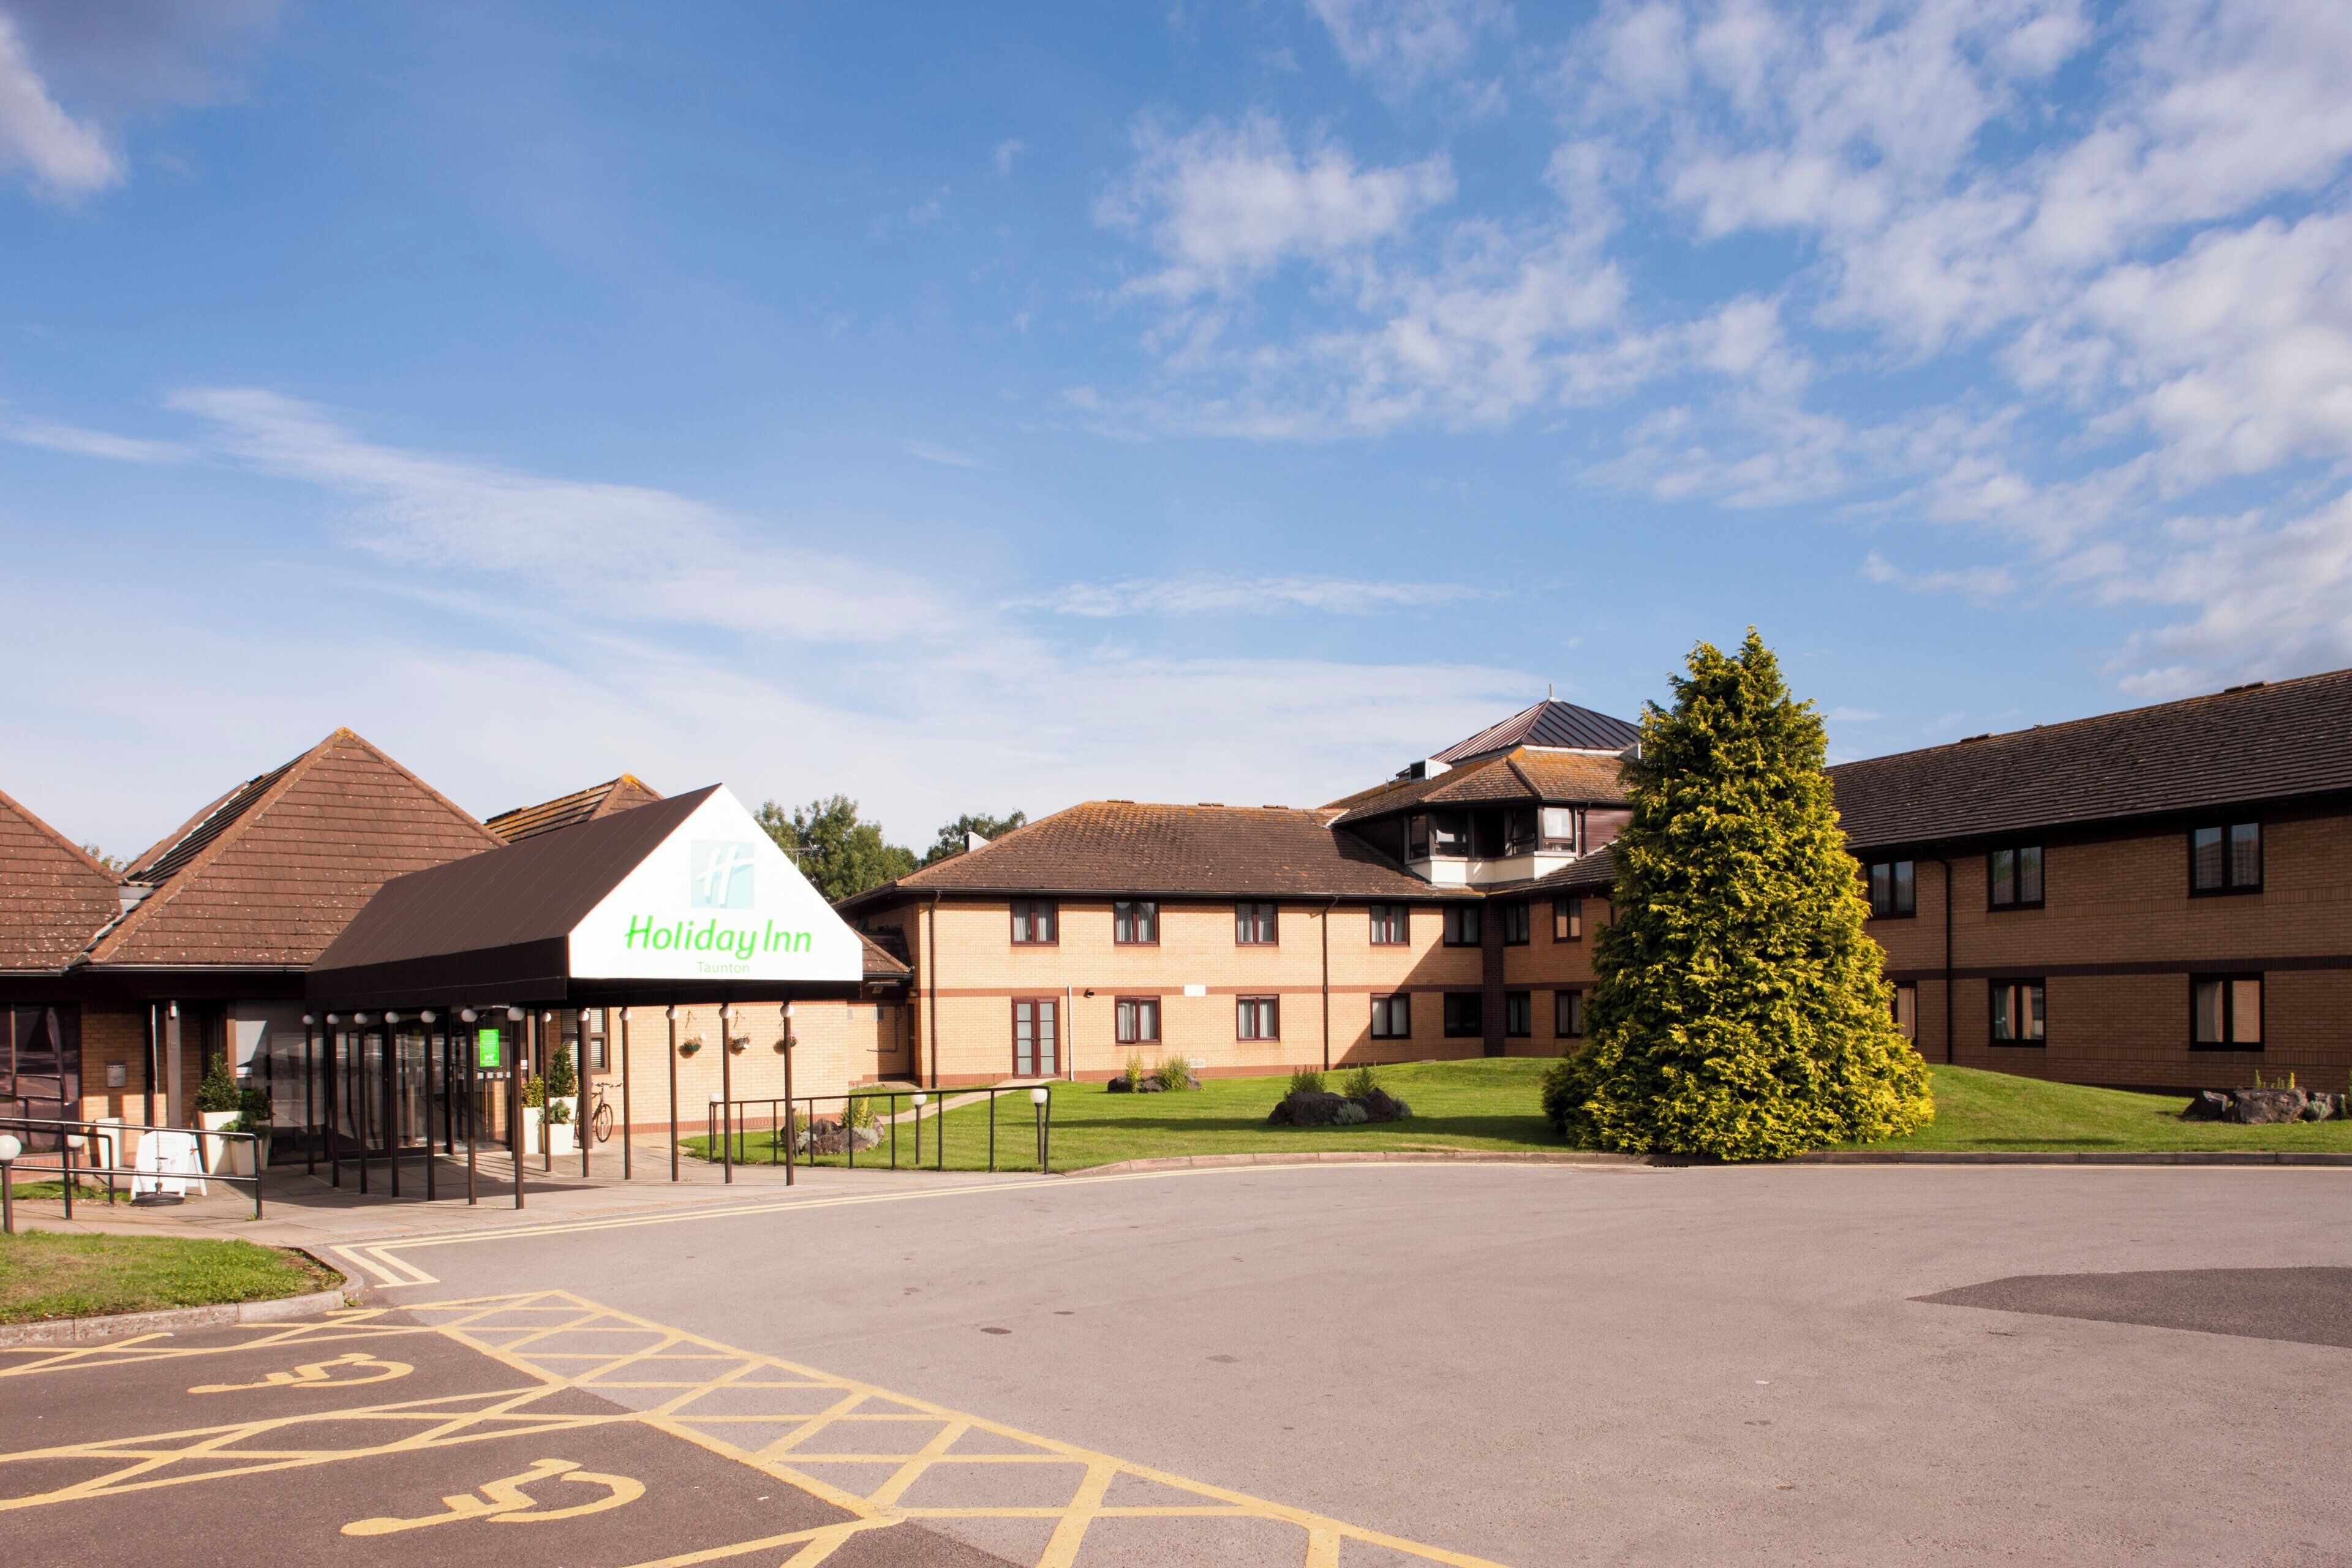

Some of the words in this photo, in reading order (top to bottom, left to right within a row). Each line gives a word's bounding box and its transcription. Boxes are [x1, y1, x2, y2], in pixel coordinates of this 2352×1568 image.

[625, 915, 757, 960] Holiday
[764, 919, 812, 952] Inn
[697, 961, 750, 973] Taunton
